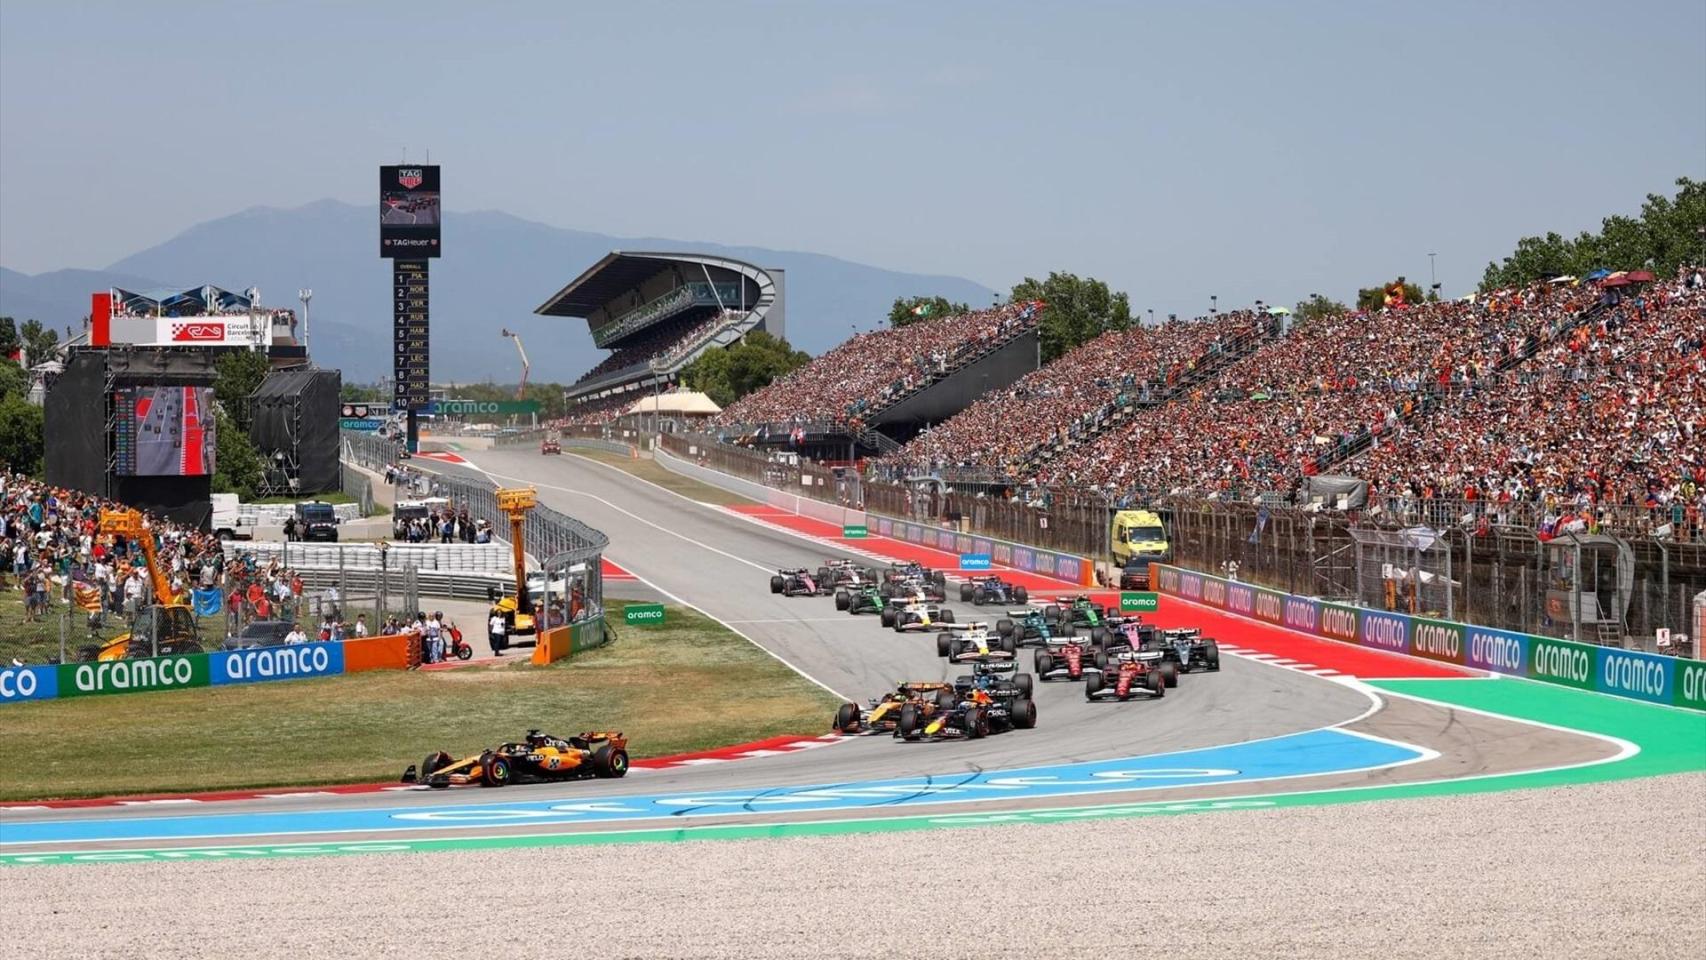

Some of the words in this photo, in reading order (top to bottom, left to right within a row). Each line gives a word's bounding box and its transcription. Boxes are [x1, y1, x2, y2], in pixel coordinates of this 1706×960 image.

[398, 275, 403, 283] 1
[398, 289, 404, 297] 2
[398, 302, 404, 311] 3
[398, 316, 404, 324] 4
[398, 330, 404, 338] 5
[398, 343, 404, 352] 6
[398, 357, 404, 365] 7
[399, 371, 404, 379] 8
[399, 384, 404, 393] 9
[397, 398, 407, 407] 10
[434, 402, 498, 413] aramco
[343, 420, 378, 428] aramco
[1182, 574, 1200, 598] aramco
[1204, 580, 1225, 606] aramco
[1122, 598, 1156, 606] aramco
[1229, 587, 1251, 612] aramco
[1257, 593, 1280, 621] aramco
[627, 611, 662, 619] aramco
[1287, 600, 1315, 629] aramco
[1323, 608, 1356, 638] aramco
[1366, 615, 1404, 647] aramco
[1416, 624, 1459, 658] aramco
[1472, 633, 1520, 669] aramco
[226, 646, 329, 679] aramco
[1535, 643, 1589, 682] aramco
[0, 669, 37, 698] co
[76, 658, 192, 691] aramco
[1605, 655, 1664, 696] aramco
[389, 768, 1241, 820] aramco
[0, 845, 412, 863] ramco
